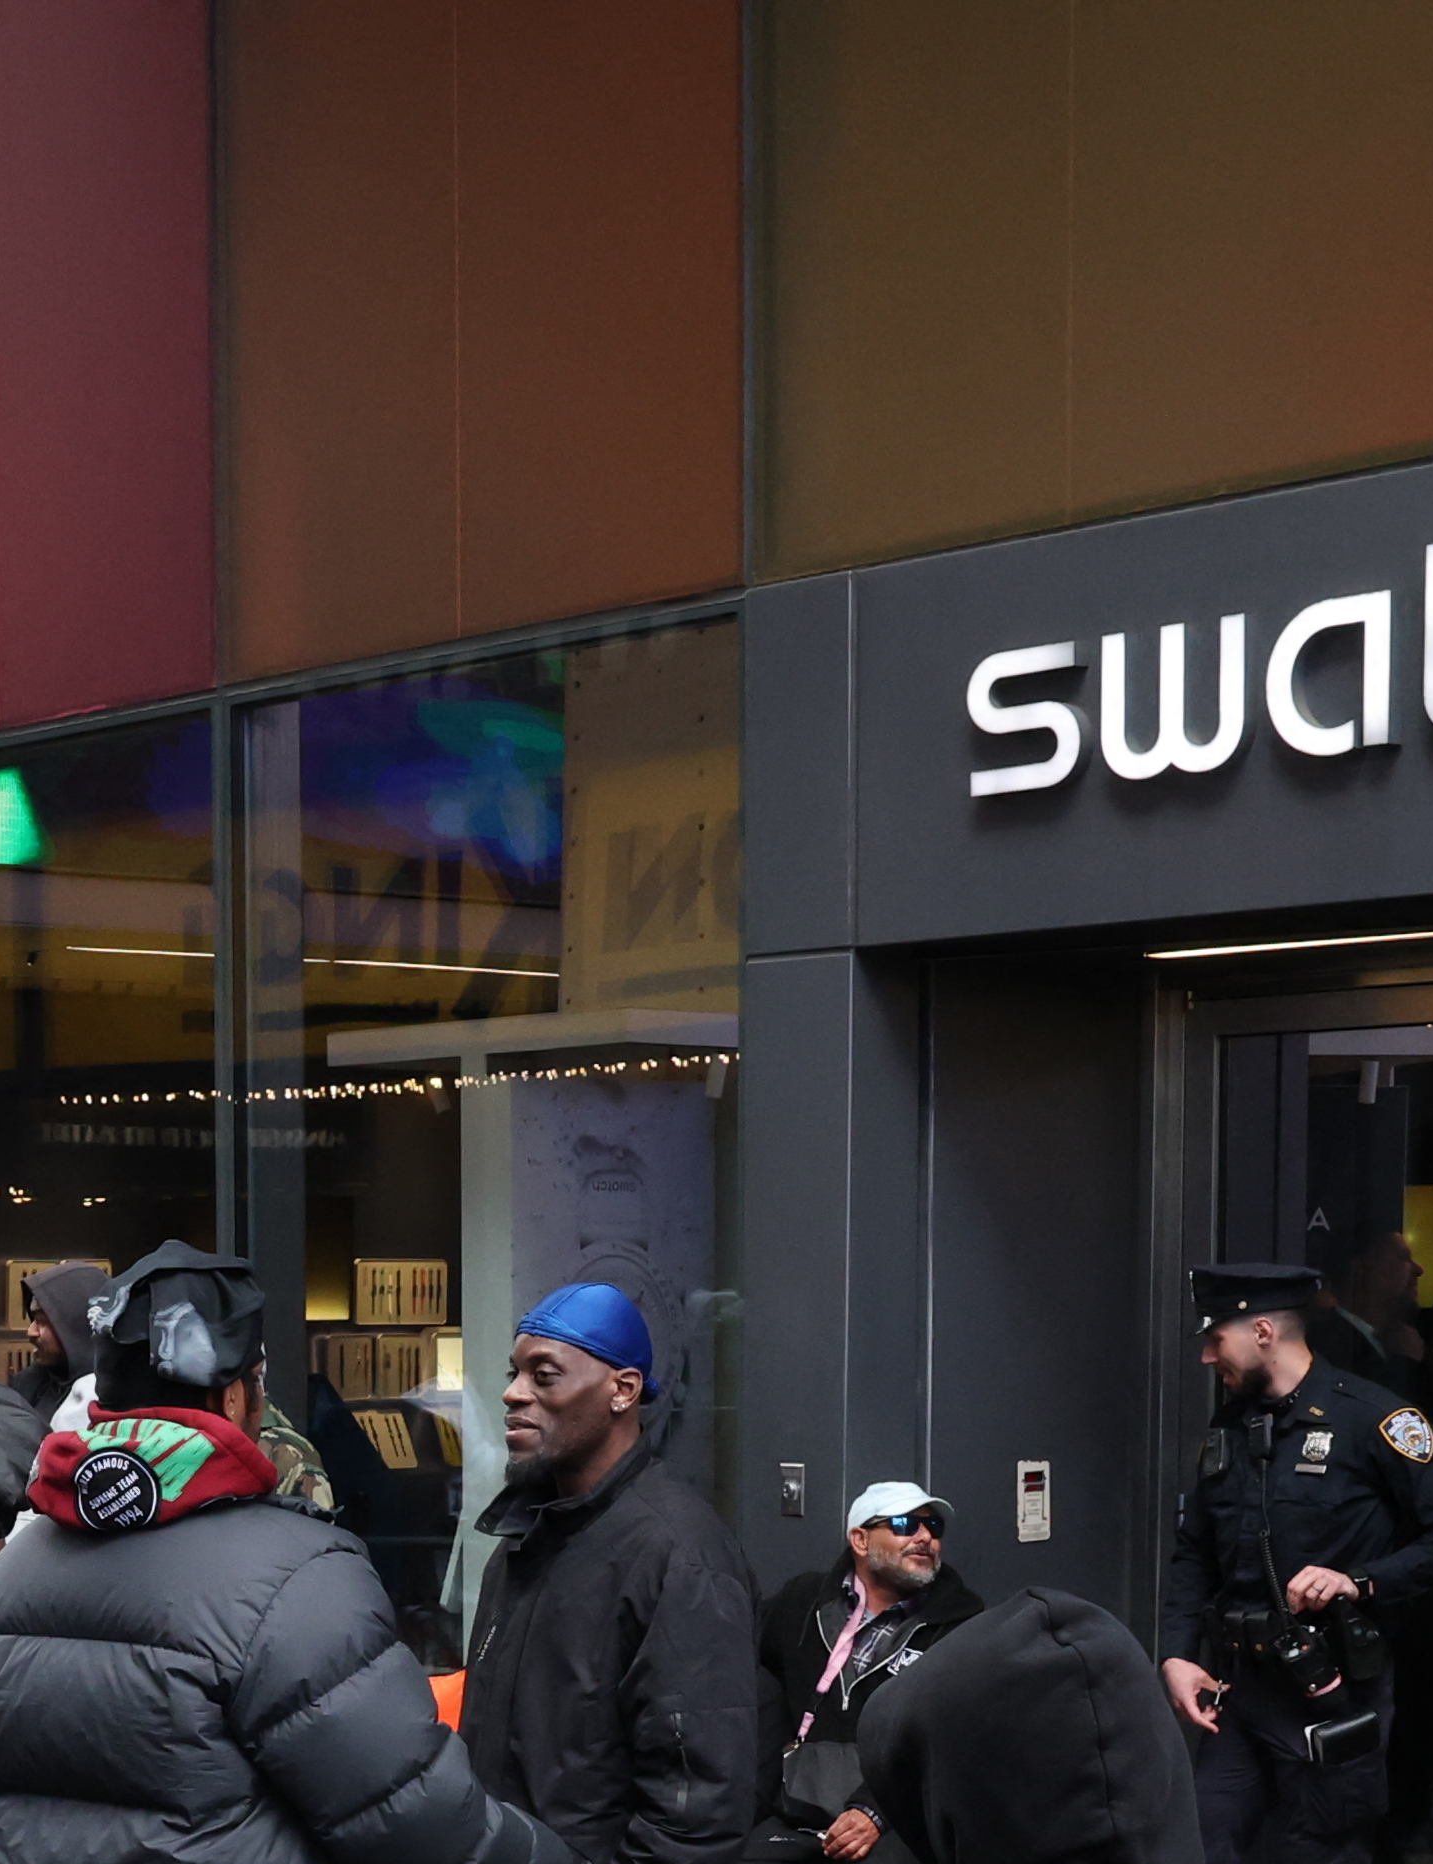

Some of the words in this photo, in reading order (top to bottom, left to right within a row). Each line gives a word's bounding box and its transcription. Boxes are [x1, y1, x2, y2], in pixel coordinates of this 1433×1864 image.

[93, 1457, 130, 1473] FAMOUS
[116, 1470, 140, 1491] TEAM
[97, 1485, 142, 1521] ESTABLISHED
